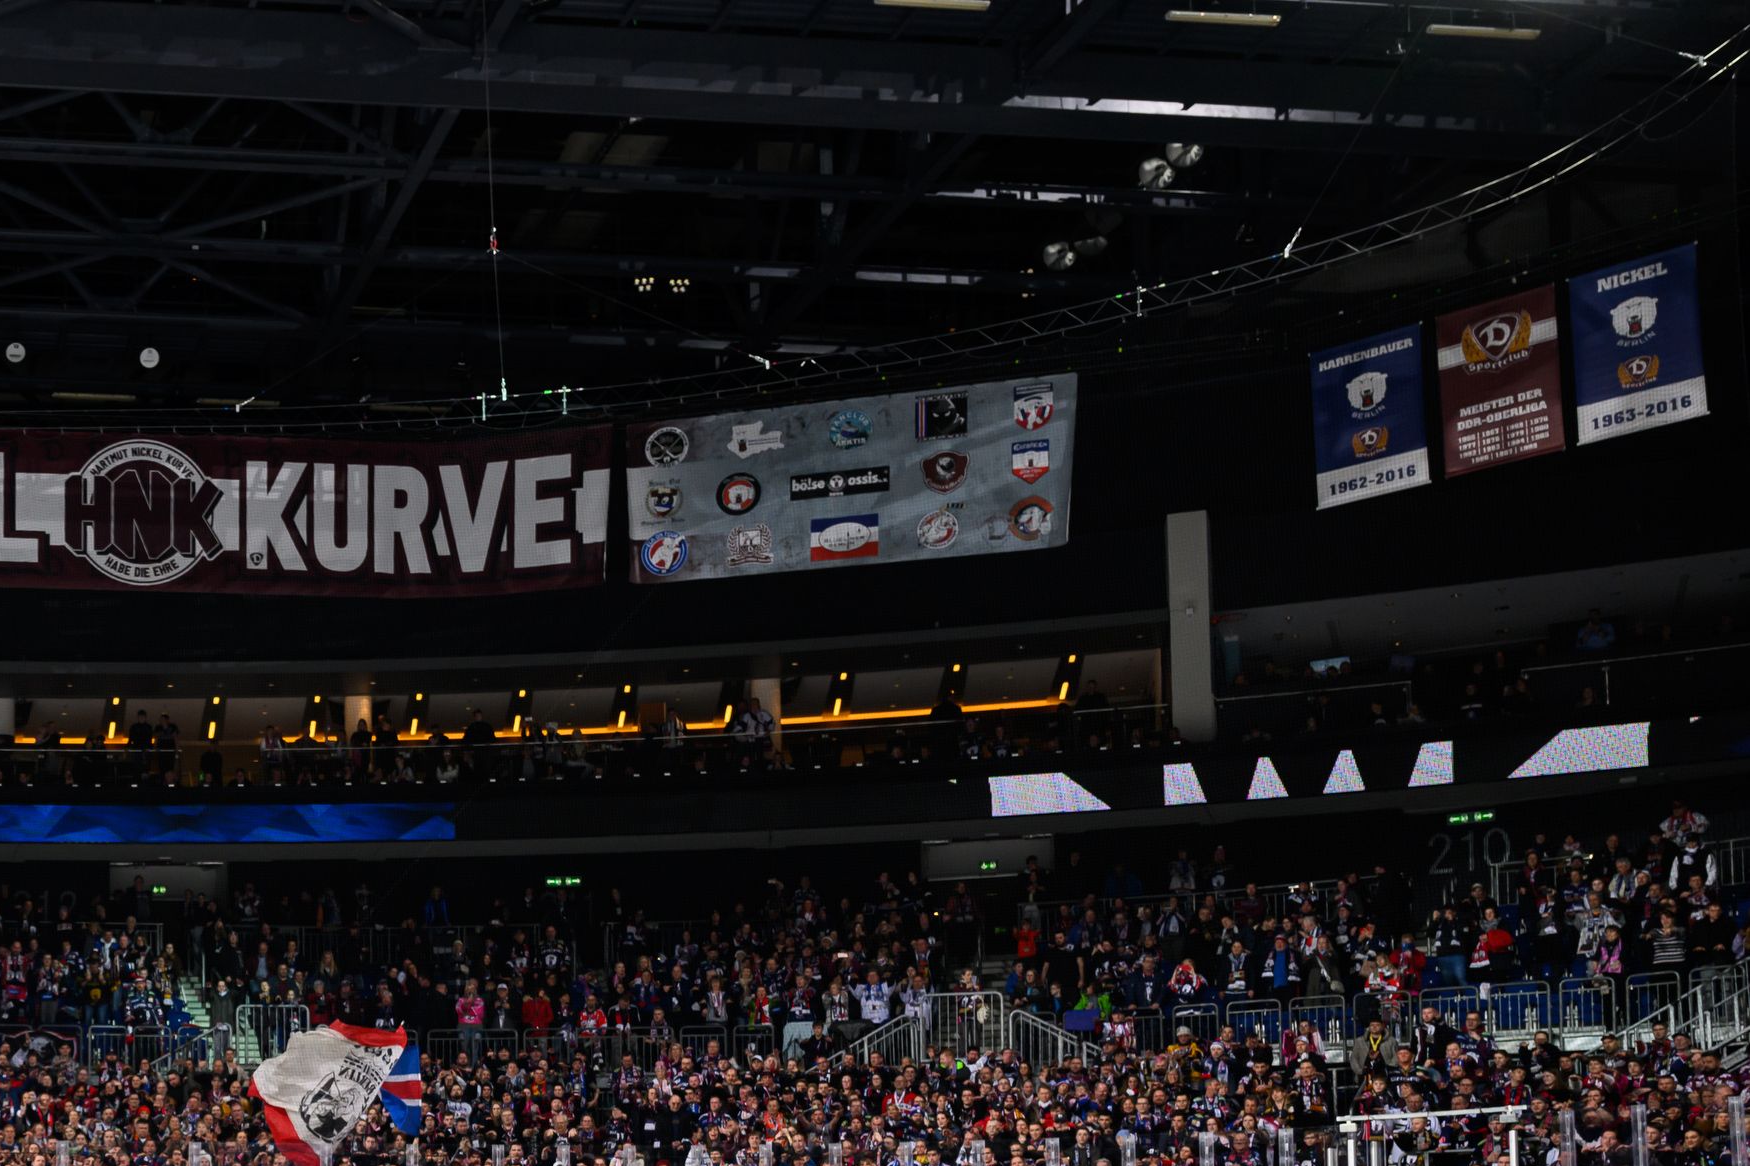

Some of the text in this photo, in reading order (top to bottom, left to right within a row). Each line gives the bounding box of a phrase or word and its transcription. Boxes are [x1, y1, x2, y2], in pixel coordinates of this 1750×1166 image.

[1597, 262, 1668, 293] NICKEL
[1318, 338, 1413, 372] KARRENBAUER
[1468, 349, 1529, 372] Sportclub
[1457, 400, 1547, 432] DDR-OBERLIGA
[1459, 387, 1543, 418] MEISTER DER
[1592, 395, 1692, 431] 1963-2016
[90, 447, 194, 478] HARTMUT NICKEL KURVE
[1330, 465, 1416, 496] 1962-2016
[64, 469, 224, 561] HNK
[246, 453, 572, 575] KURVE
[105, 557, 179, 577] HABE DIE EHRE
[1427, 827, 1511, 876] 210
